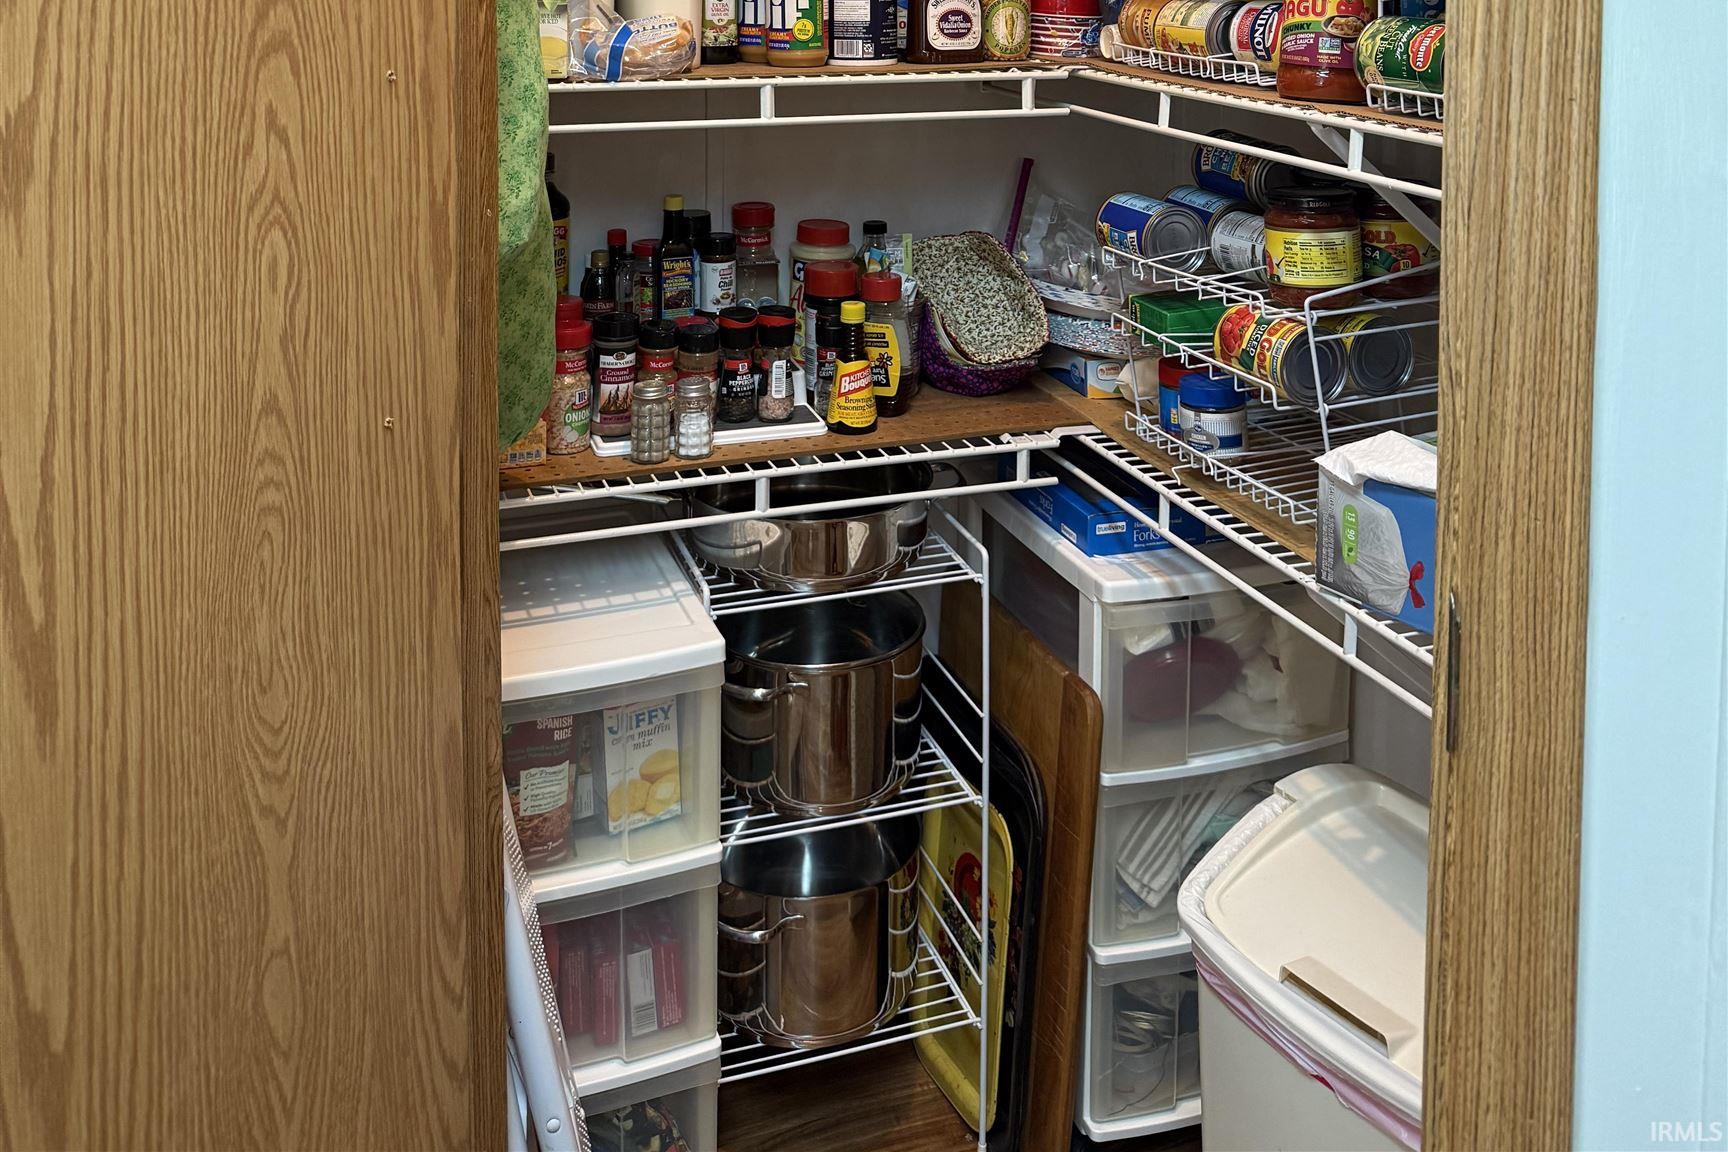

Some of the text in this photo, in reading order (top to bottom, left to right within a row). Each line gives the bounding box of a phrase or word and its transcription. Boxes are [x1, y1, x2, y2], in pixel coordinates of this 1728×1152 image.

[1253, 4, 1279, 60] MILNOT
[1386, 30, 1400, 50] CUT
[994, 42, 1026, 54] POPCORN
[1415, 38, 1430, 68] Monte
[1376, 40, 1388, 72] BEANS
[740, 236, 768, 244] McCormick
[663, 260, 691, 270] Wright's
[1402, 260, 1410, 269] 10
[1249, 324, 1268, 357] DICED
[872, 367, 885, 375] Pure
[600, 374, 635, 382] Cinnamon
[836, 402, 866, 411] Seasoning
[1133, 530, 1161, 542] Forks
[536, 715, 573, 730] SPANISH
[553, 727, 573, 741] RICE
[638, 723, 671, 740] muffin
[632, 738, 653, 752] mix
[525, 770, 537, 780] Our
